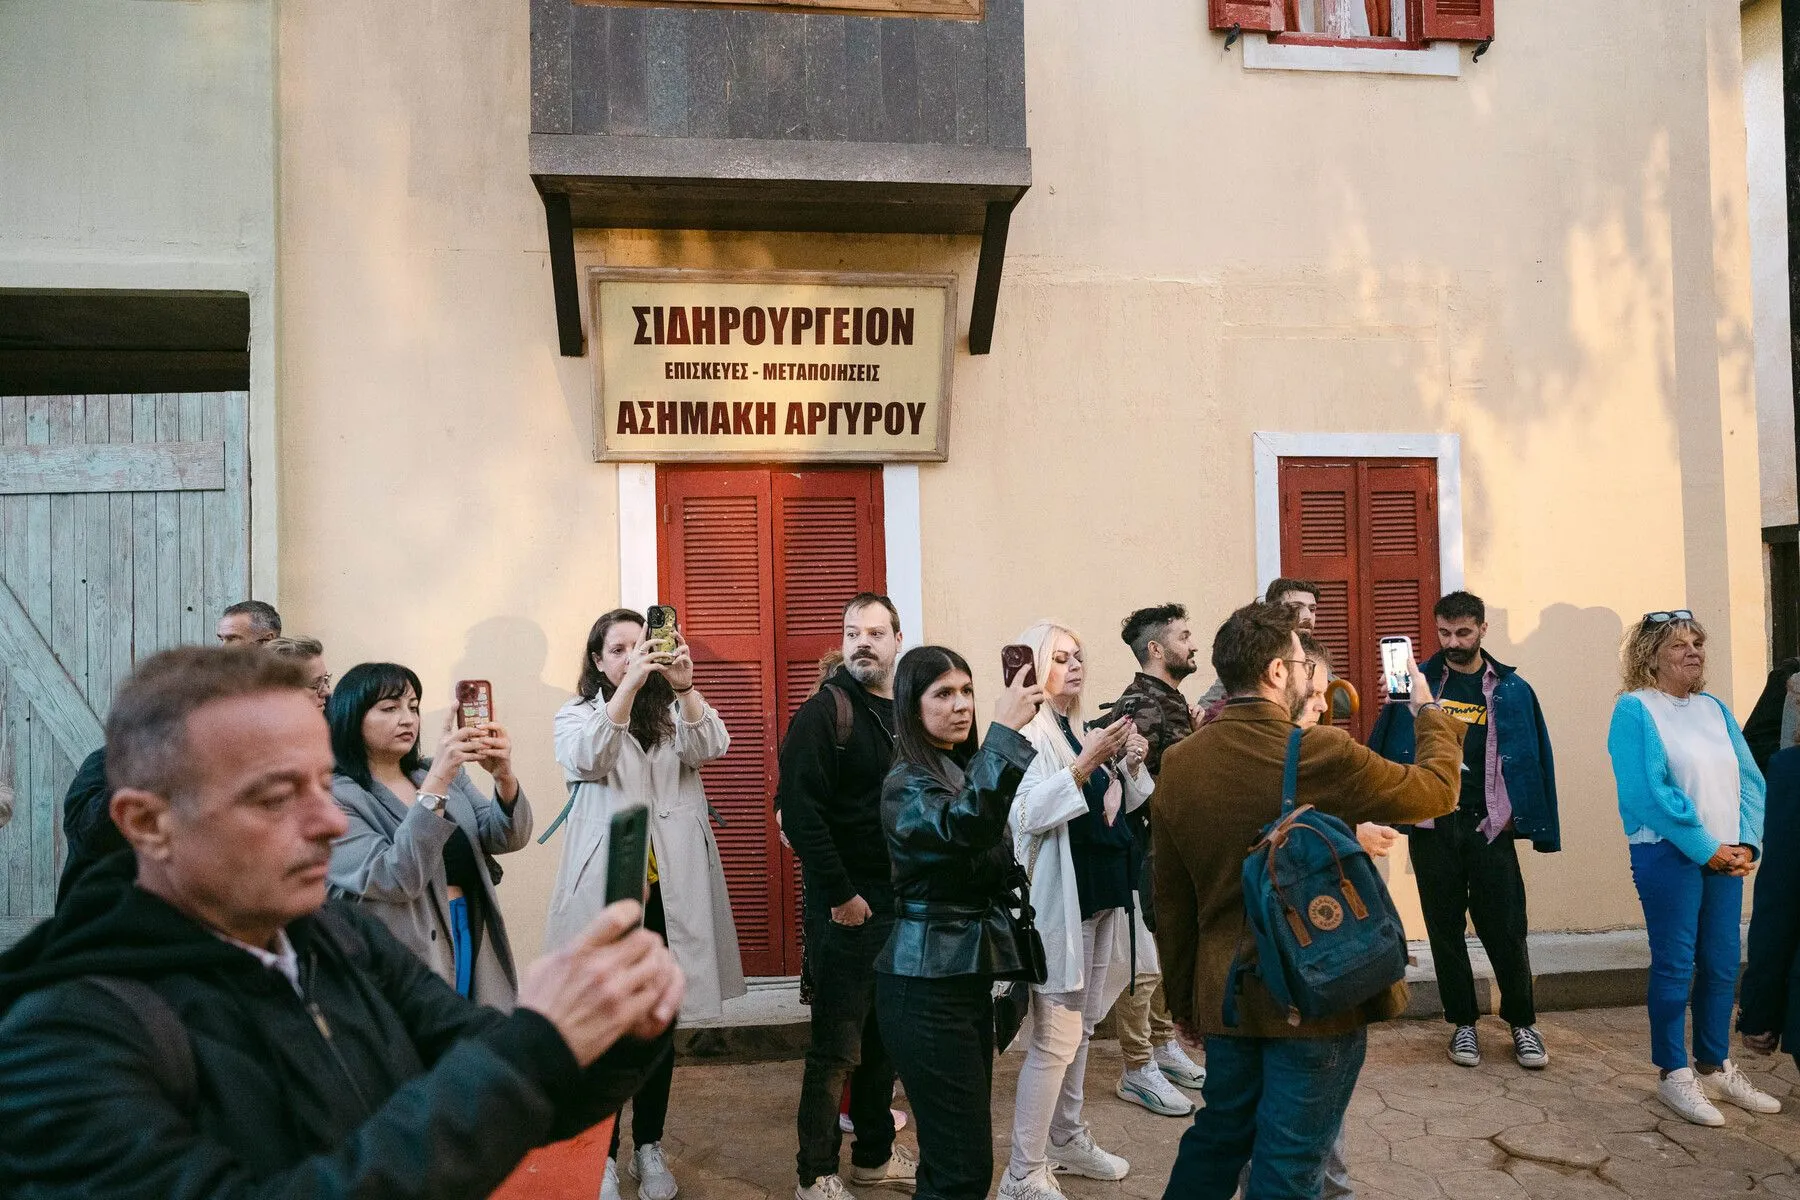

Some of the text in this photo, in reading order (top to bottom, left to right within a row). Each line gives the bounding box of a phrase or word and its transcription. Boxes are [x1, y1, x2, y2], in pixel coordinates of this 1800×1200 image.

[631, 305, 915, 346] ΣΙΔΗΡΟΥΡΓΕΙΟΝ
[664, 361, 749, 381] ΕΠΙΣΚΕΥΕΣ
[762, 362, 881, 382] ΜΕΤΑΠΟΙΗΣΕΙΣ
[616, 400, 927, 436] ΑΣΗΜΑΚΗ ΑΡΓΥΡΟΥ
